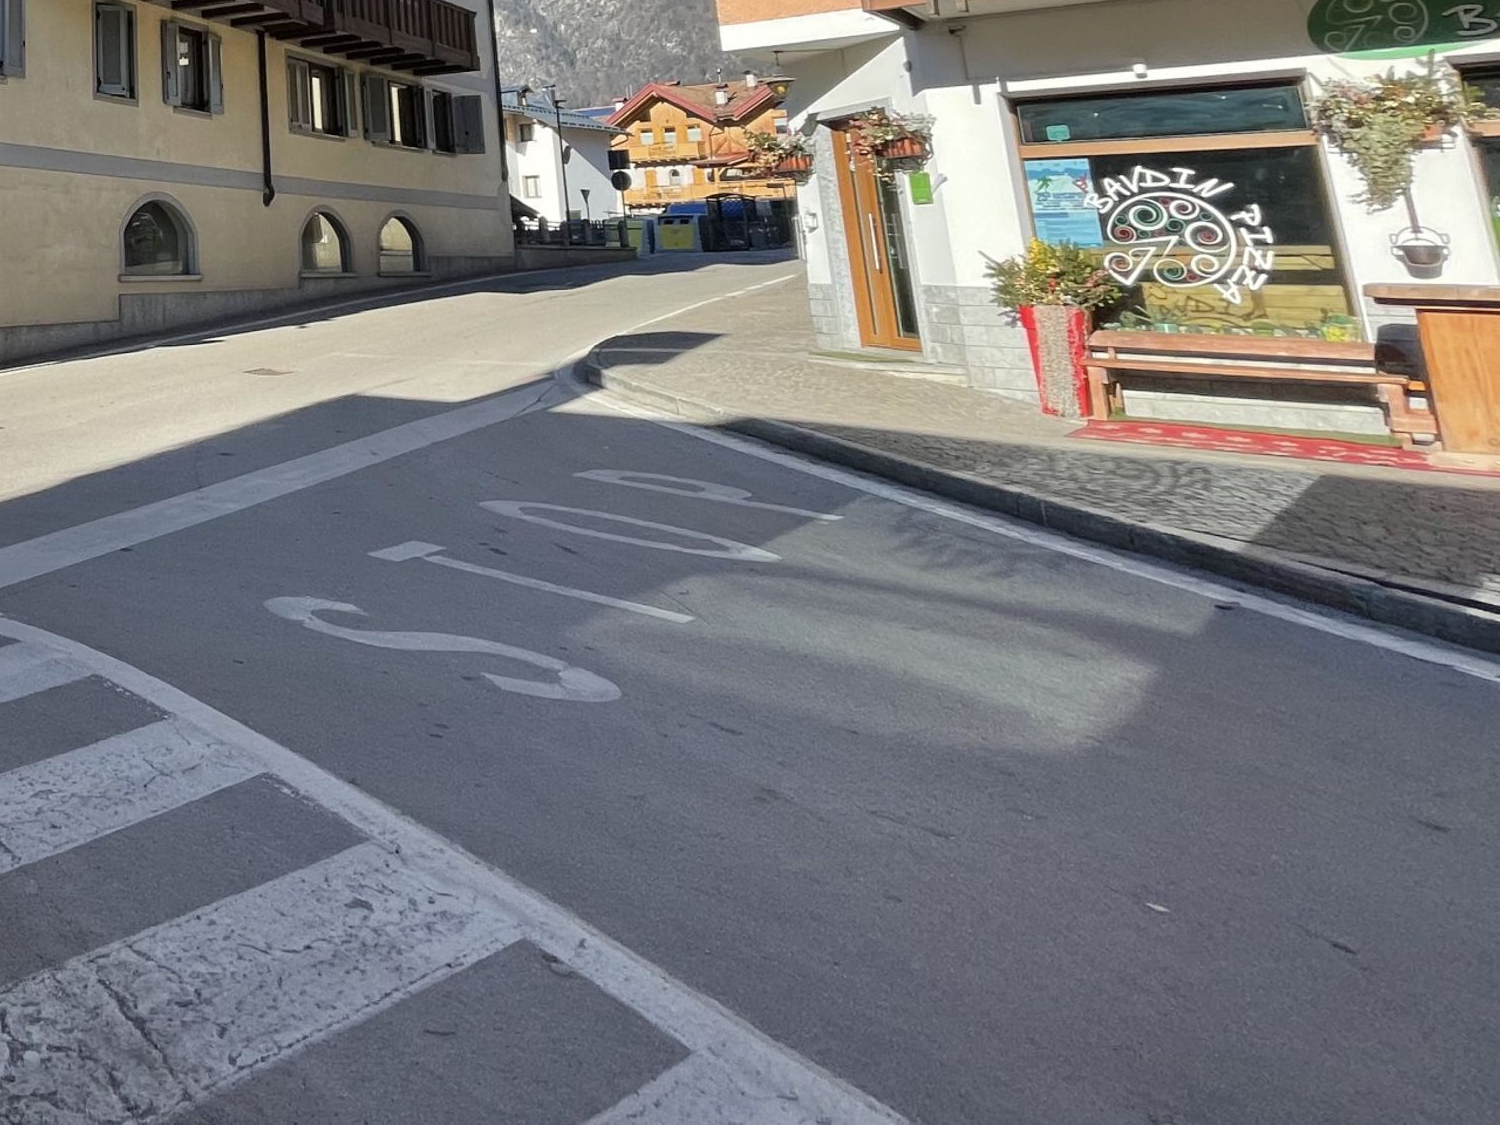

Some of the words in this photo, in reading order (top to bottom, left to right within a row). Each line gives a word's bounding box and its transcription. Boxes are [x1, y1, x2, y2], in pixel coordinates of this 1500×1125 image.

[1441, 3, 1500, 37] B
[1213, 203, 1276, 305] PIZZA
[263, 469, 845, 703] STOP
